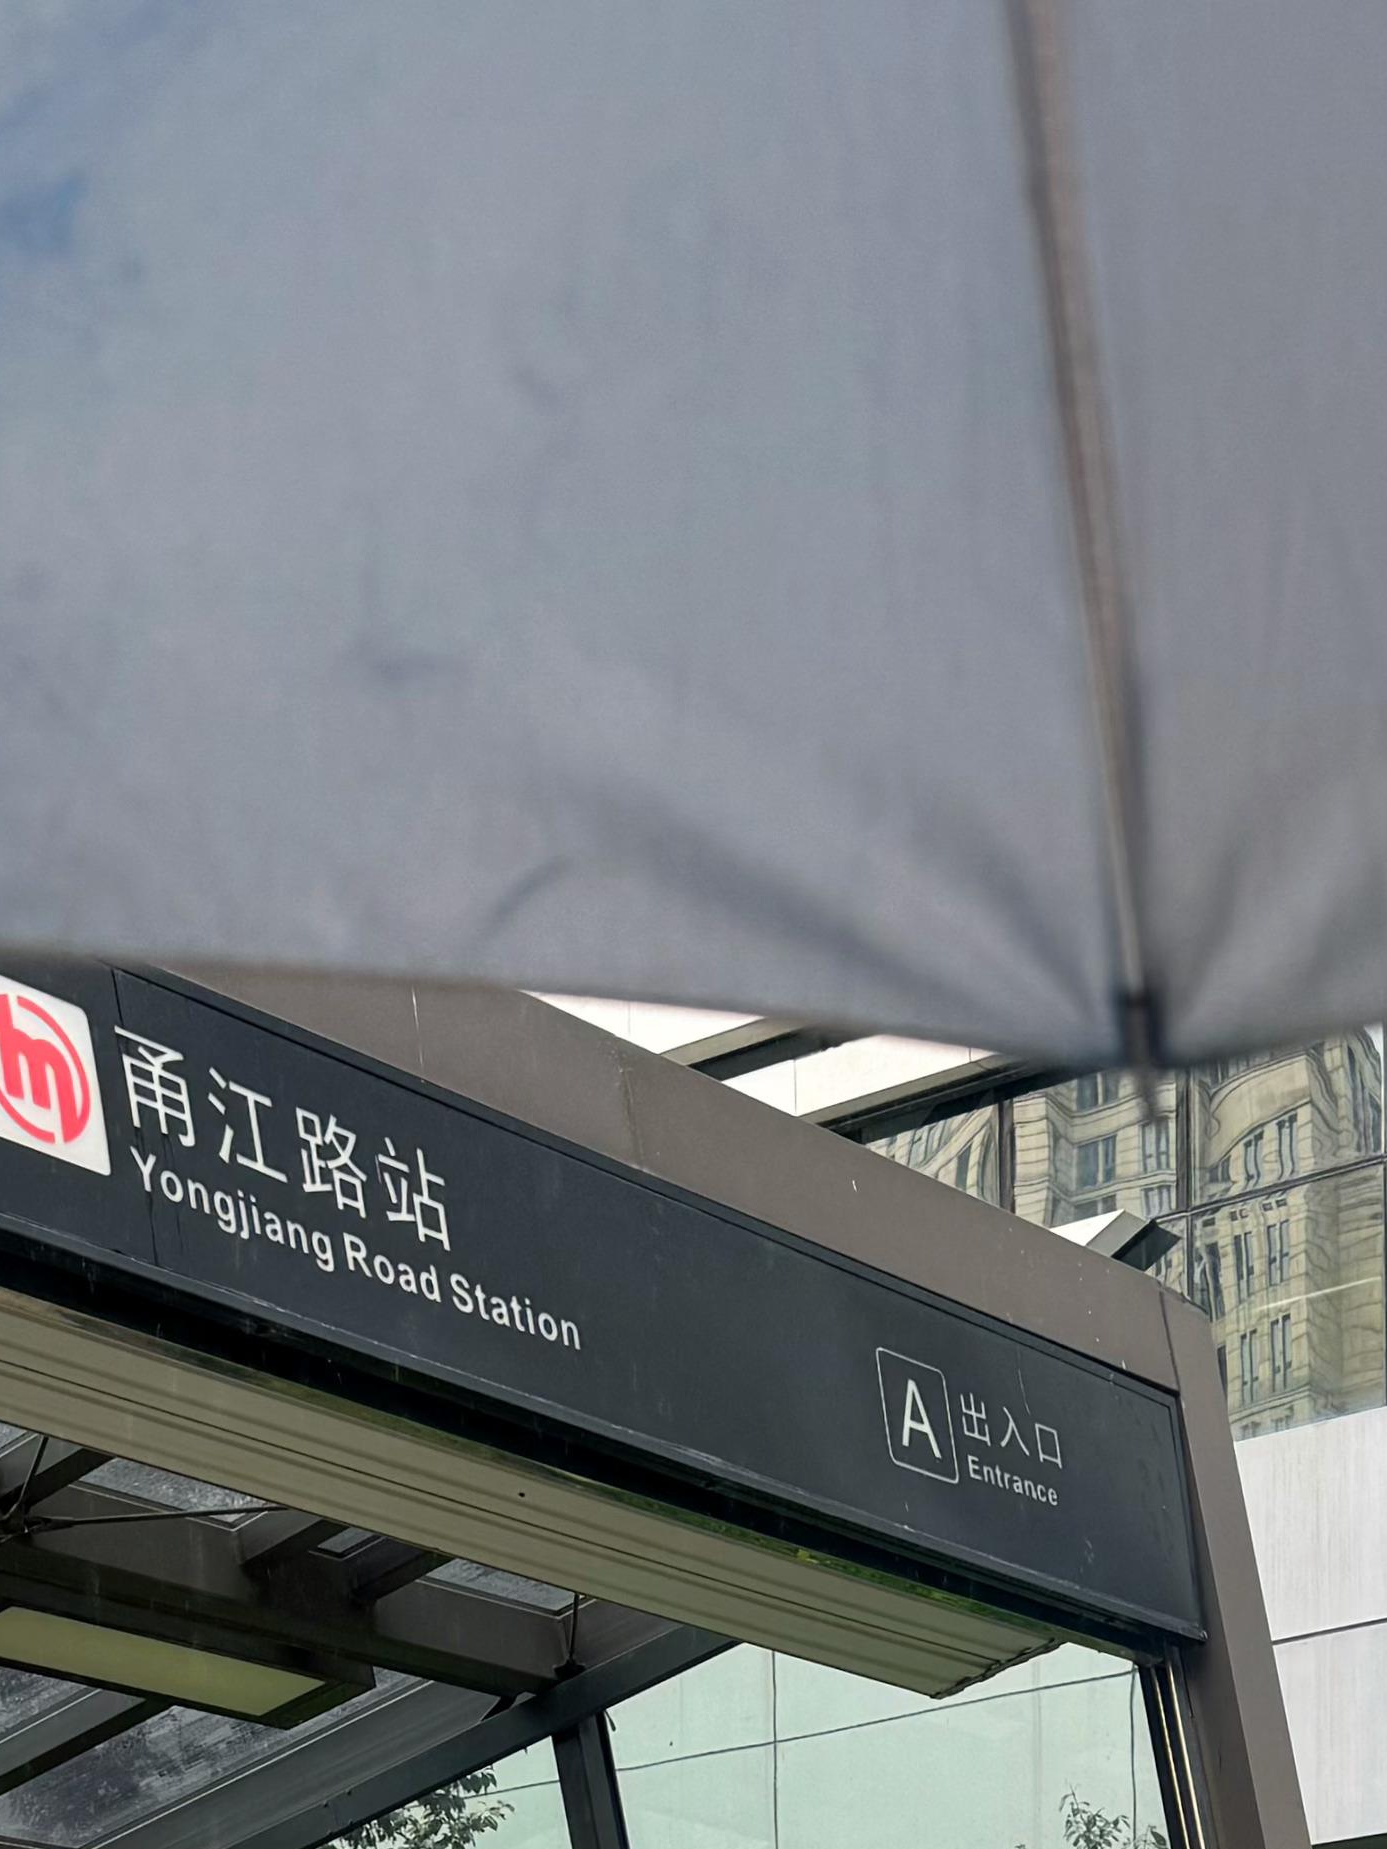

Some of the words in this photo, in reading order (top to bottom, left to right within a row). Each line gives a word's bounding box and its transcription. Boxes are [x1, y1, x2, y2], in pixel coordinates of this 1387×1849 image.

[114, 1025, 450, 1251] 甬江路站
[130, 1146, 335, 1272] Yongjiang
[343, 1232, 442, 1303] Road
[449, 1273, 581, 1350] Station
[901, 1378, 942, 1459] A
[960, 1392, 1062, 1469] 出入口
[967, 1454, 1059, 1506] Entrance
